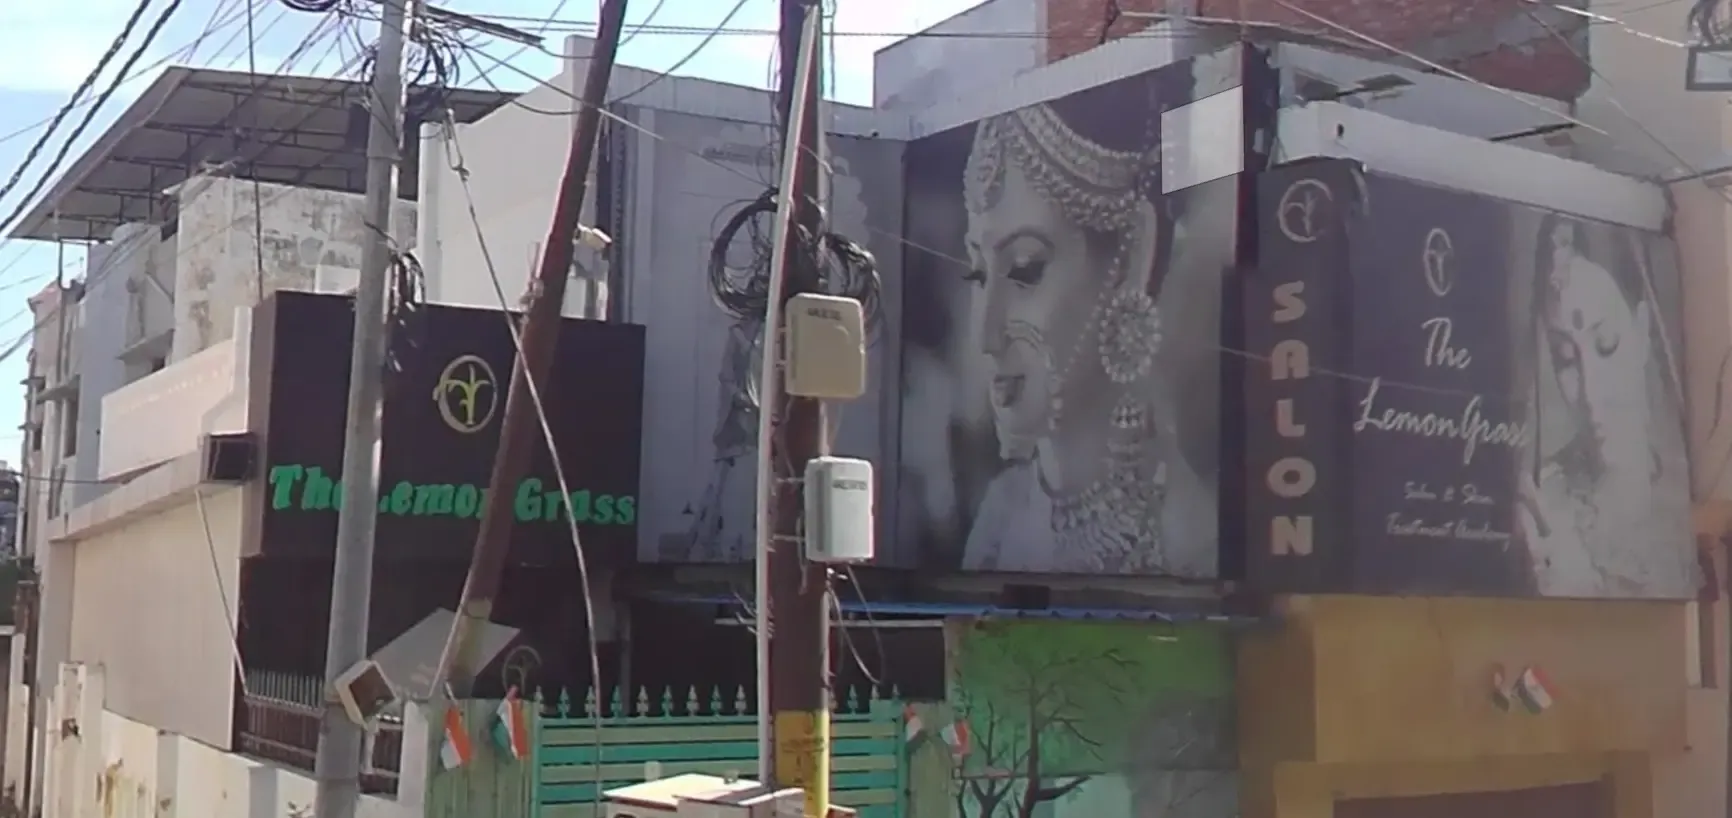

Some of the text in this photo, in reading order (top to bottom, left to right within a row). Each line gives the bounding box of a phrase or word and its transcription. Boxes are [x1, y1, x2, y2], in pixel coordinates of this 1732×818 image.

[1421, 317, 1472, 369] The
[1267, 281, 1316, 556] SALON
[513, 477, 635, 525] Grass
